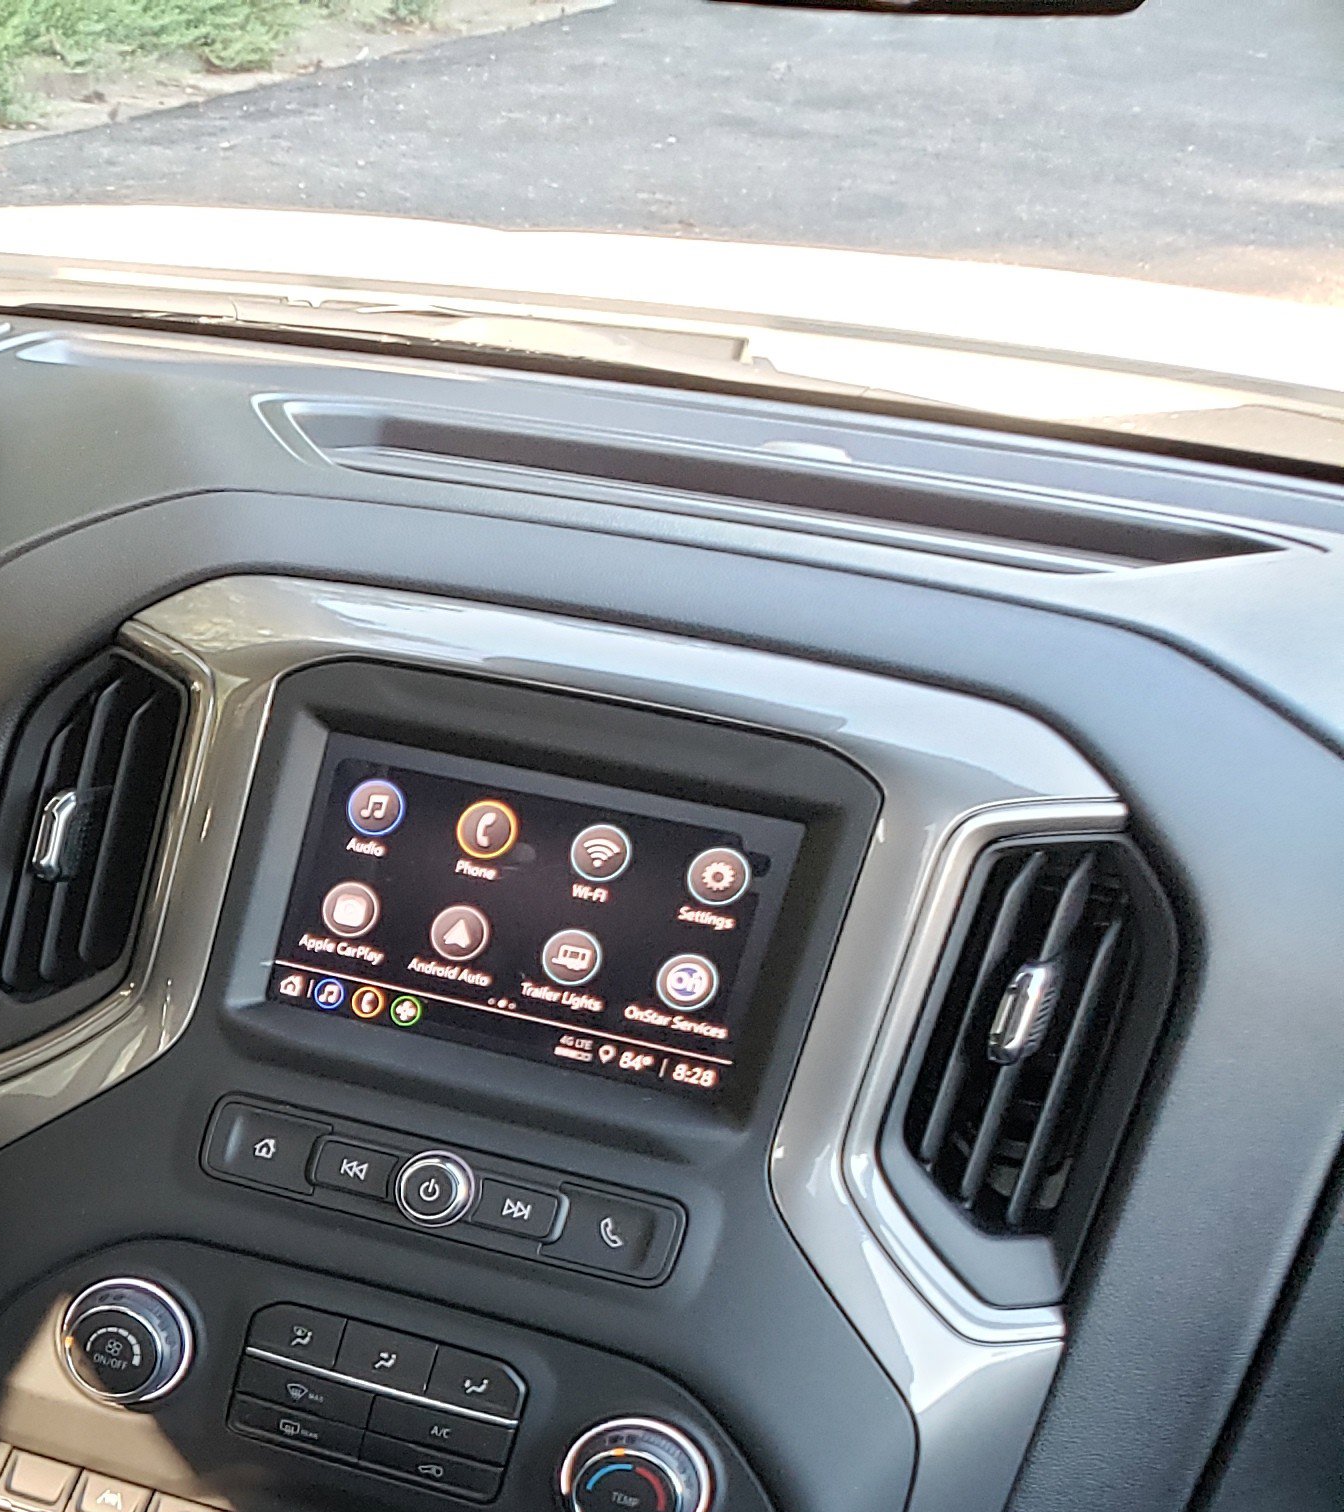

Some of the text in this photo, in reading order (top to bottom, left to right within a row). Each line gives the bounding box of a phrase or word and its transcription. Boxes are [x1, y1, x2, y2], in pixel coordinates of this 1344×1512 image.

[346, 837, 386, 857] Audio
[455, 858, 499, 881] Phone
[676, 905, 737, 931] Settings
[298, 933, 385, 966] Apple CarPlay
[407, 957, 493, 987] Android Auto
[520, 980, 605, 1012] Trailer Lights
[623, 1004, 729, 1040] OnStar Services
[575, 1038, 594, 1050] LTE
[672, 1062, 718, 1087] 8:28
[93, 1353, 129, 1371] ON/OFF
[430, 1425, 451, 1439] A/C
